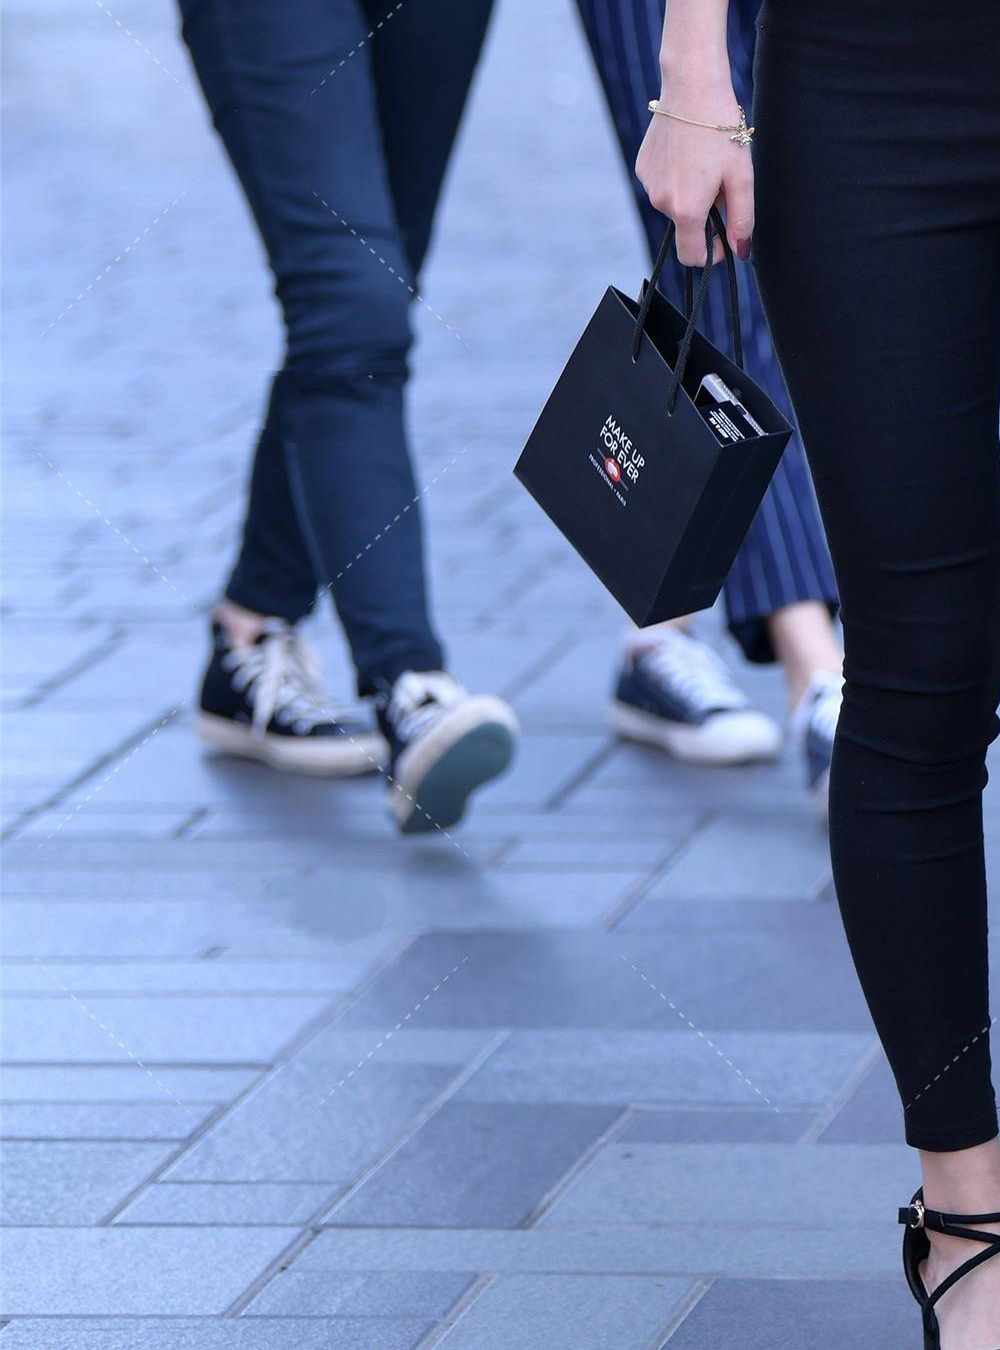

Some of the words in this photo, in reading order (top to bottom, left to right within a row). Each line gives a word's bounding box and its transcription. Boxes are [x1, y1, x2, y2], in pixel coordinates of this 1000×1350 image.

[600, 426, 618, 456] FOR
[617, 450, 639, 484] EVER
[605, 415, 632, 454] MAKE
[631, 449, 645, 468] UP
